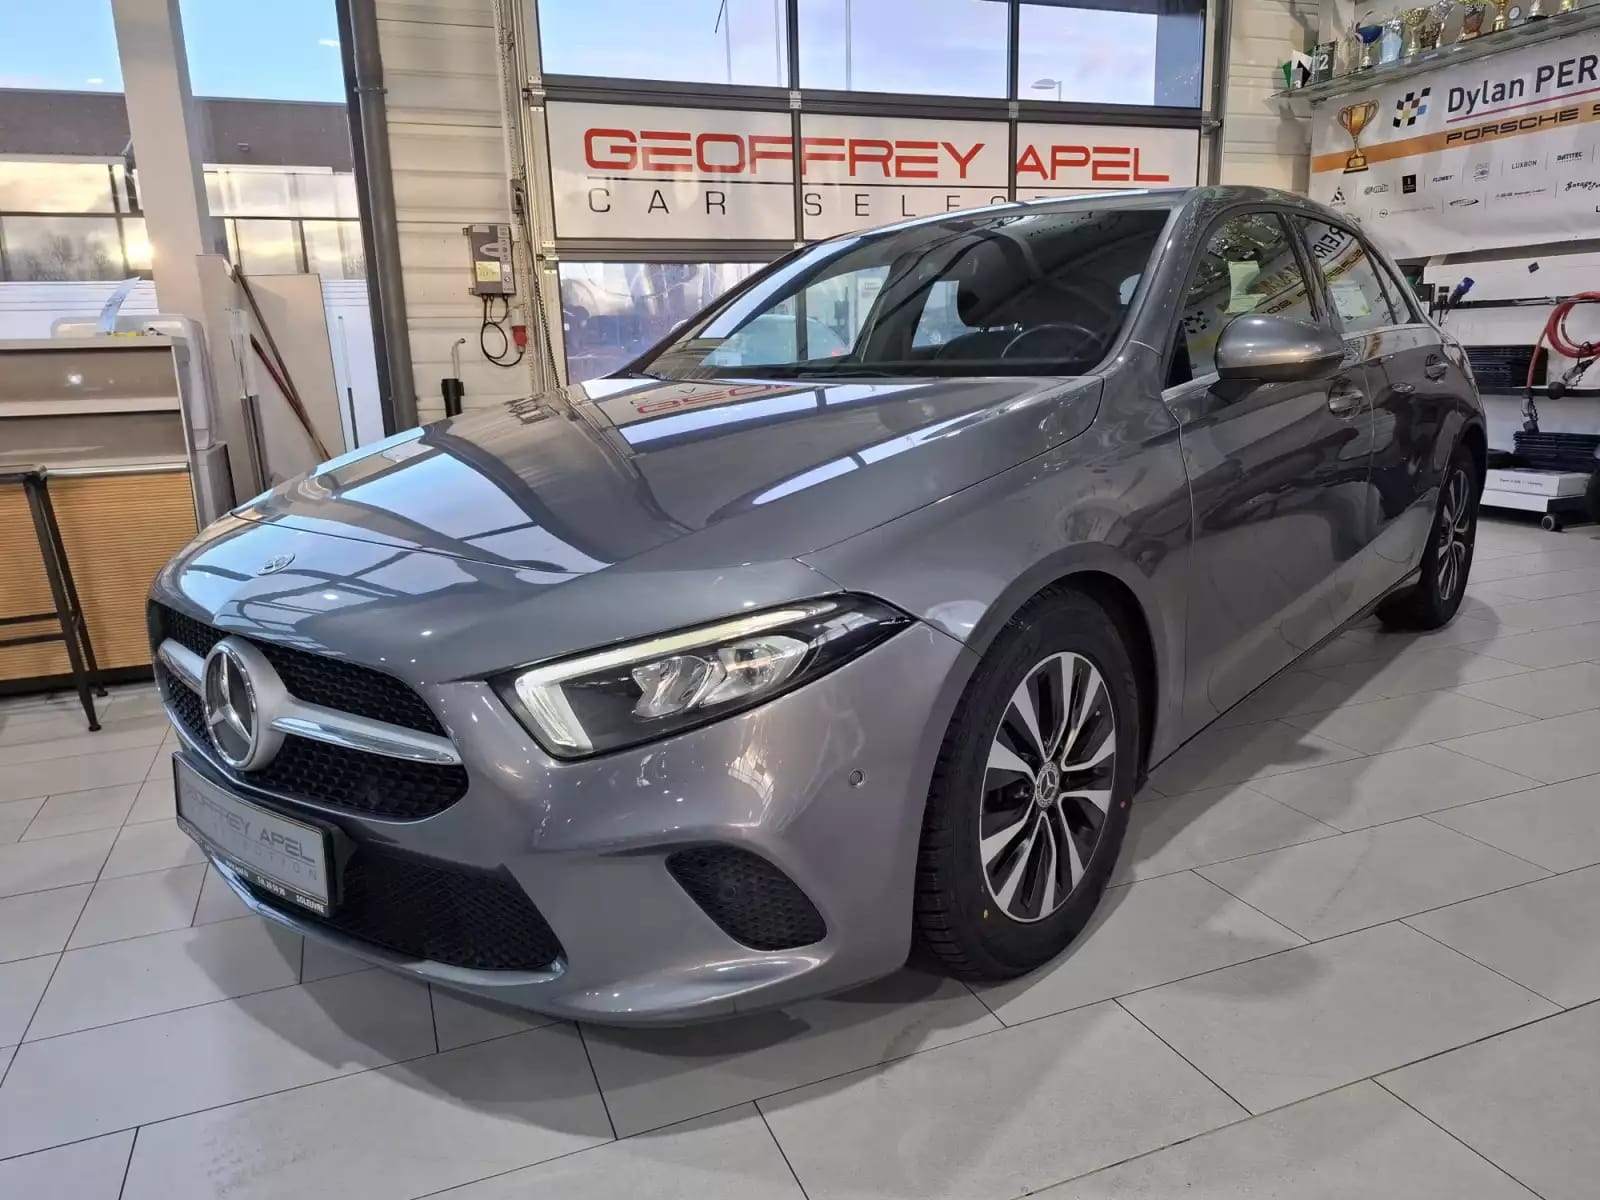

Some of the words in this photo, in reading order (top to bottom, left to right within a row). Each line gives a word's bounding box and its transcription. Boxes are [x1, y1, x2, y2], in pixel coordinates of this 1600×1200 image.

[1447, 78, 1525, 115] Dylan
[1446, 108, 1579, 144] PORSCHE
[584, 128, 985, 179] GEOFFREY
[1017, 144, 1170, 182] APEL
[588, 188, 728, 214] CAR
[804, 192, 1048, 217] SELE
[260, 827, 316, 863] APEL
